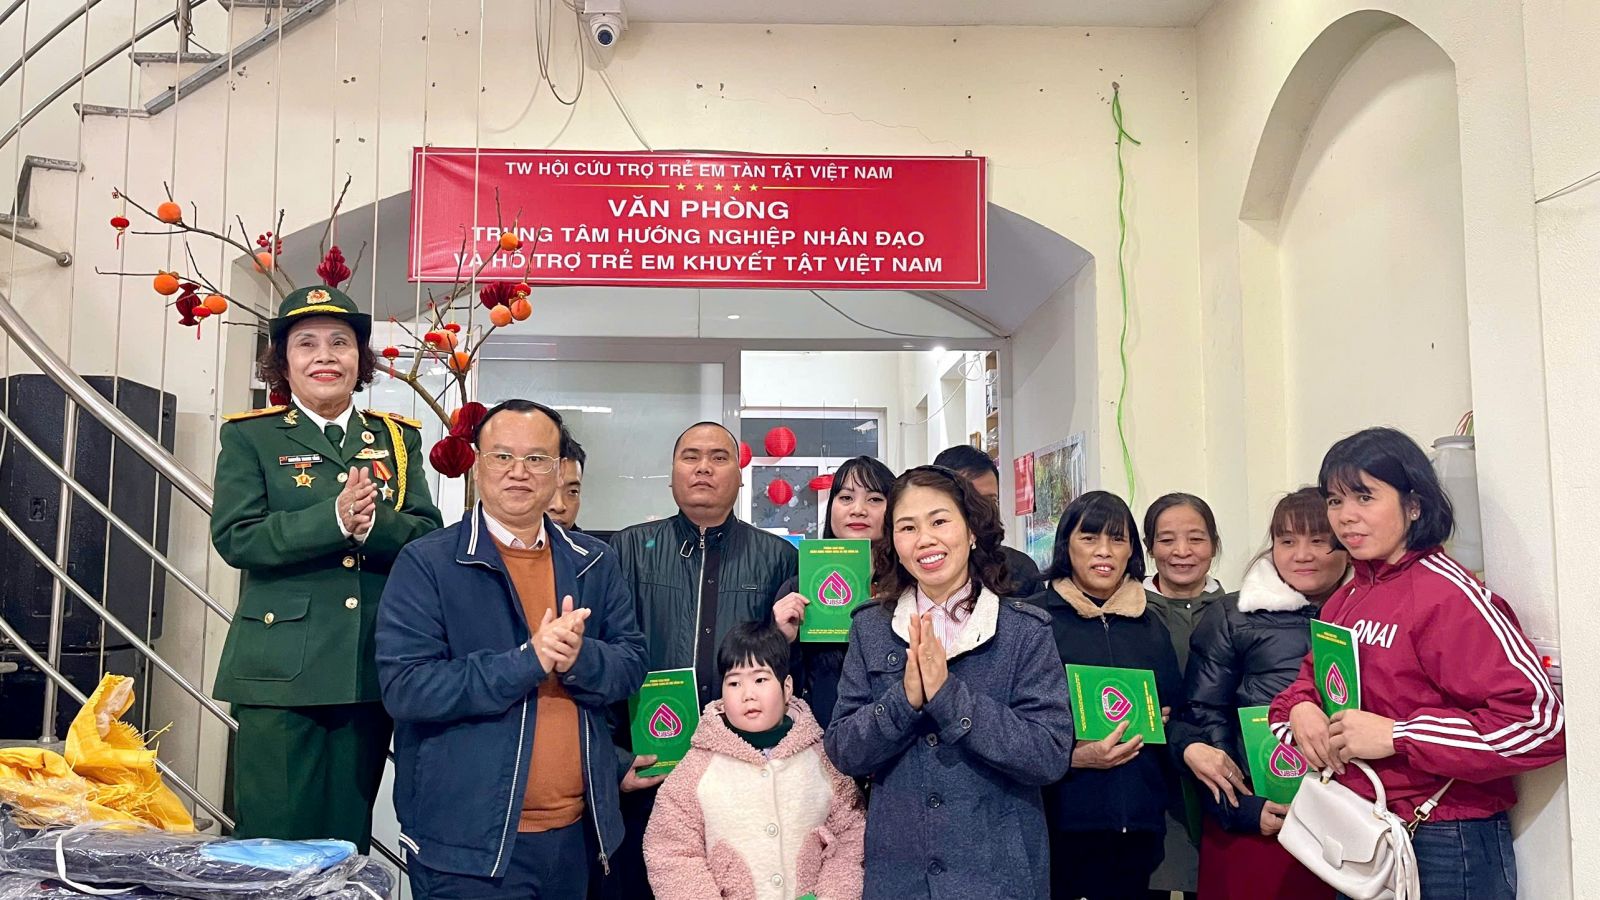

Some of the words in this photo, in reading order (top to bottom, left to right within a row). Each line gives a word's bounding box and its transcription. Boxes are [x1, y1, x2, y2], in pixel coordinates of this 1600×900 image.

[505, 162, 532, 174] TW
[539, 160, 568, 177] HỘI
[574, 160, 611, 175] CỨU
[616, 162, 653, 178] TRỢ
[660, 159, 694, 177] TRẺ
[700, 164, 725, 177] EM
[730, 162, 765, 177] TÀN
[771, 163, 804, 180] TẬT
[810, 163, 848, 181] VIỆT
[855, 167, 892, 178] NAM
[608, 195, 669, 217] VĂN
[682, 196, 788, 219] PHÒNG
[561, 224, 608, 242] TÂM
[618, 225, 700, 243] HƯỚNG
[709, 227, 795, 247] NGHIỆP
[804, 227, 867, 245] NHÂN
[876, 232, 924, 248] ĐẠO
[533, 252, 580, 271] TRỢ
[587, 249, 632, 269] TRẺ
[642, 255, 674, 269] EM
[684, 250, 776, 270] KHUYẾT
[783, 253, 826, 274] TẬT
[835, 254, 884, 274] VIỆT
[893, 258, 941, 271] NAM
